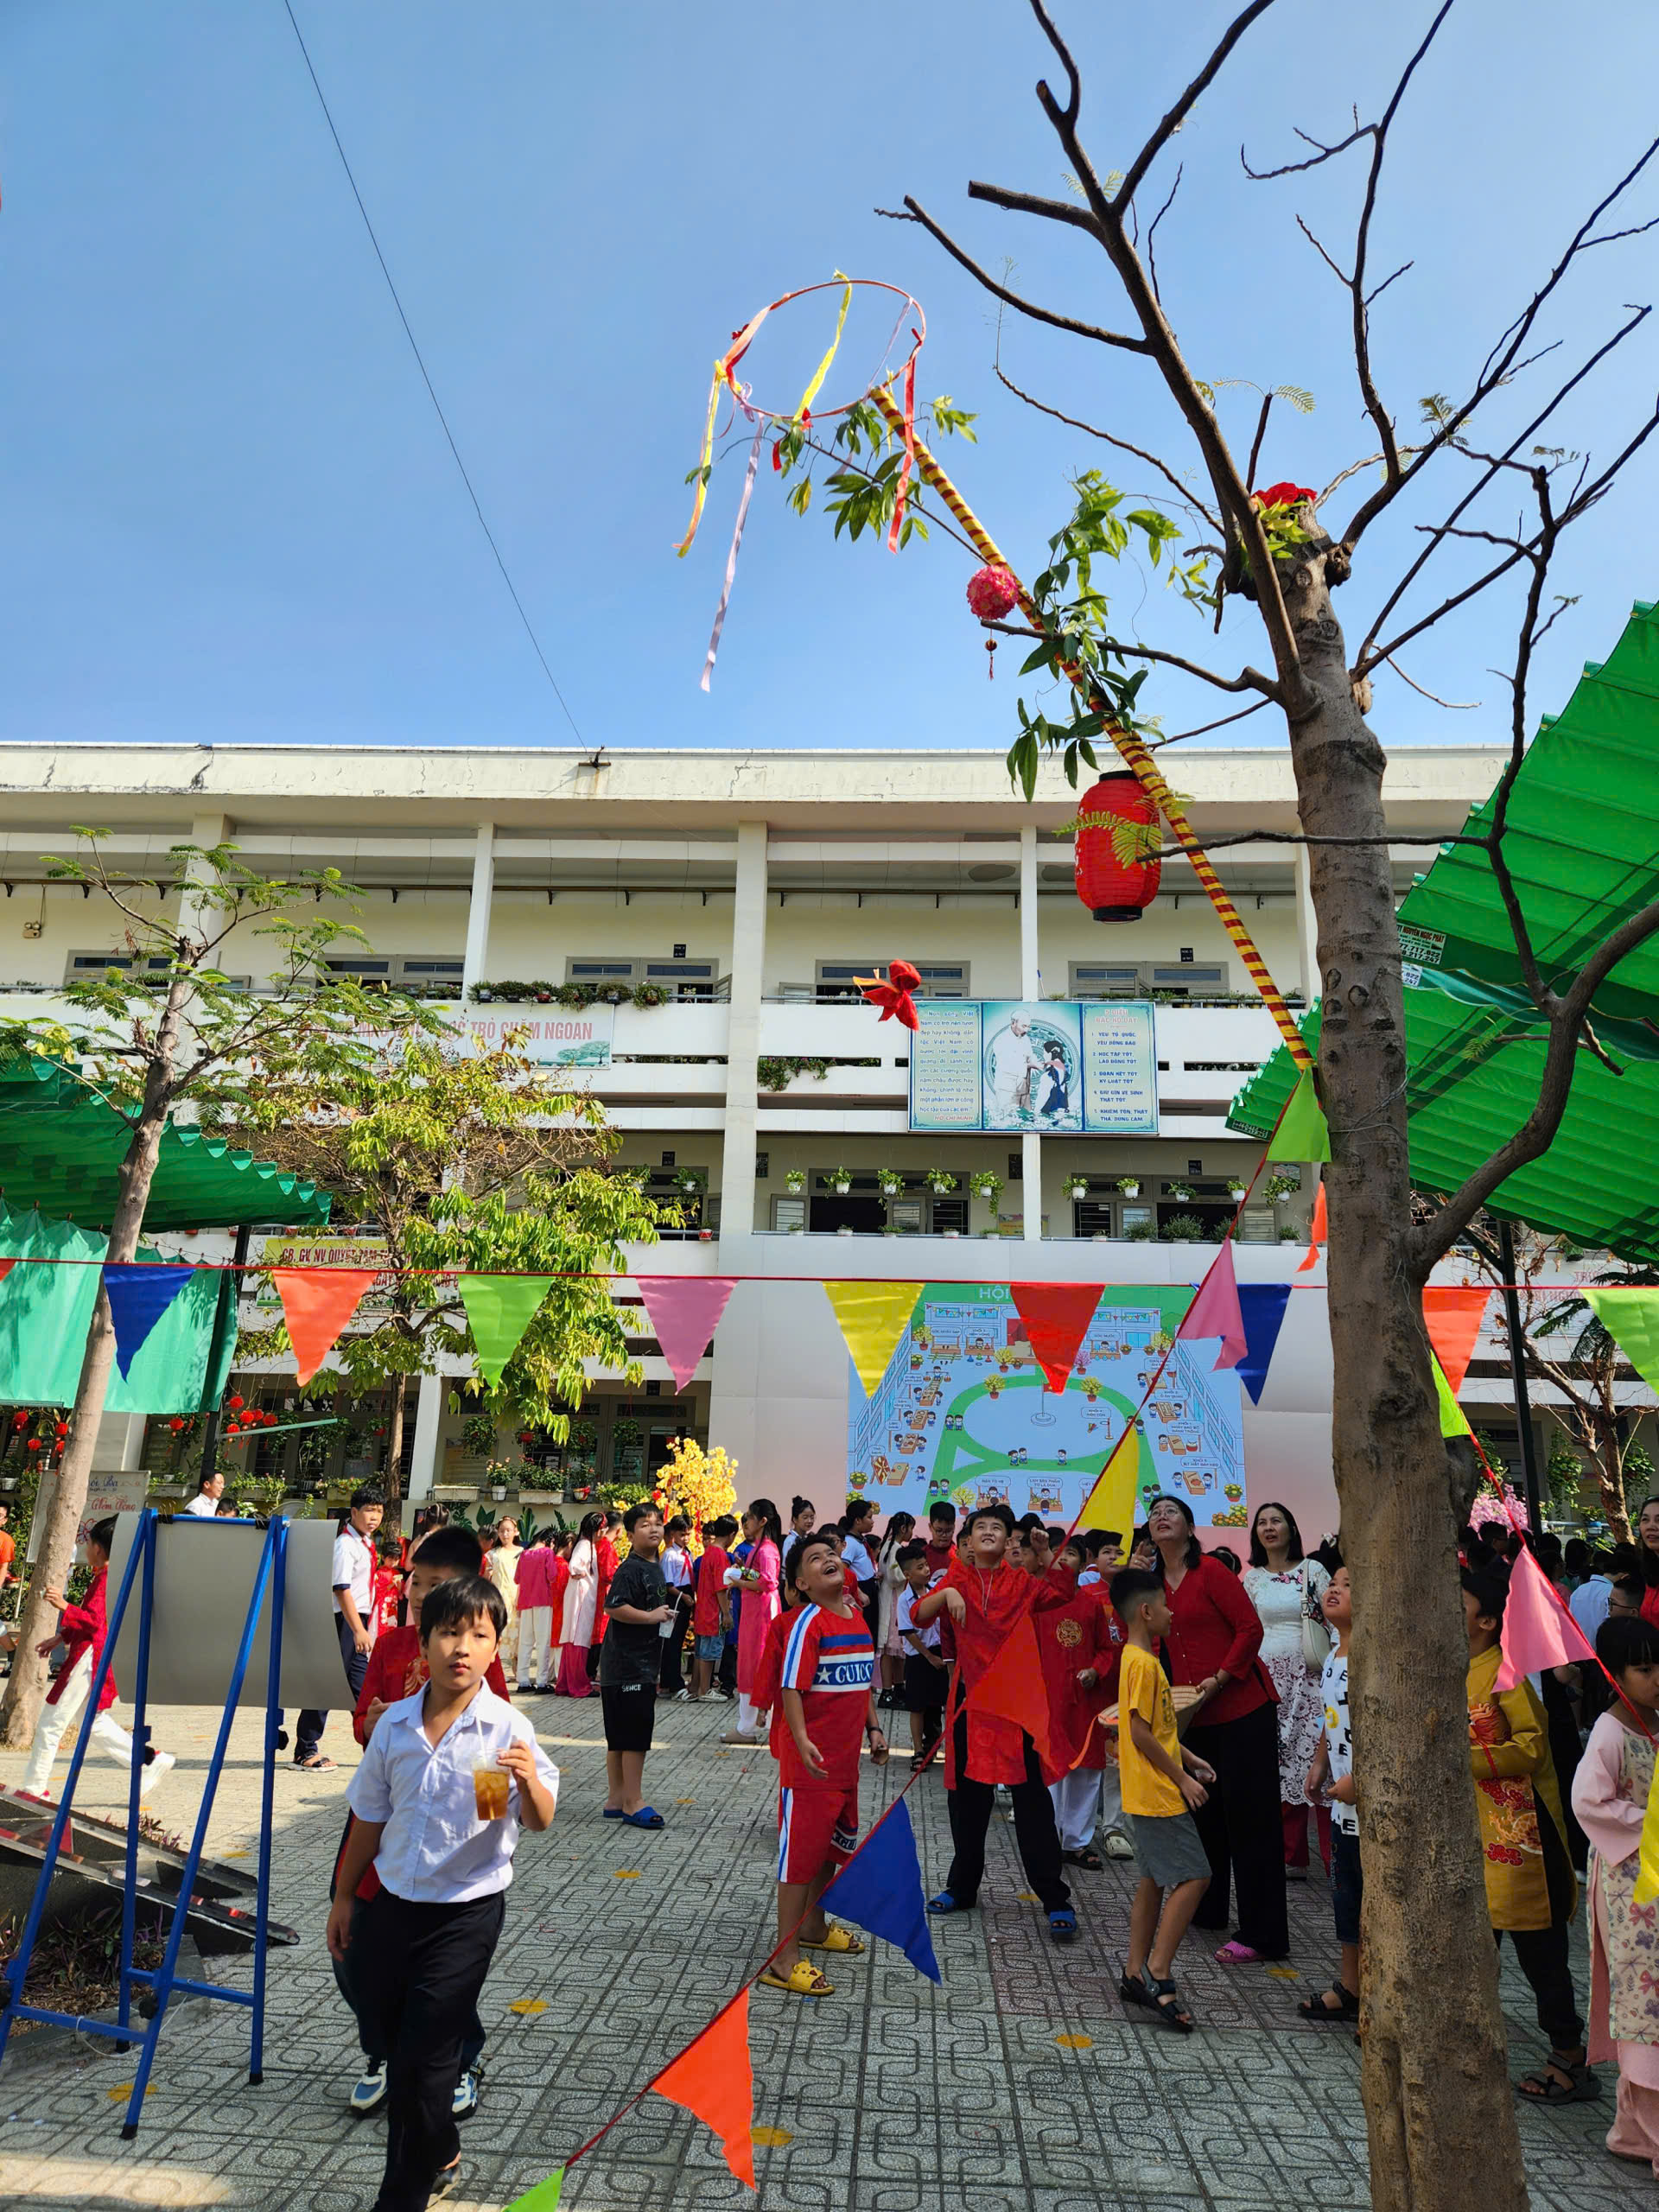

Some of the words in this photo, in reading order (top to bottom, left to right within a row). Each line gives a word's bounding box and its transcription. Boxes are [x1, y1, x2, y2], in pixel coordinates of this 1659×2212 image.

[471, 1017, 496, 1039] TRÒ
[544, 1022, 593, 1040] NGOAN
[314, 1249, 326, 1262] NV
